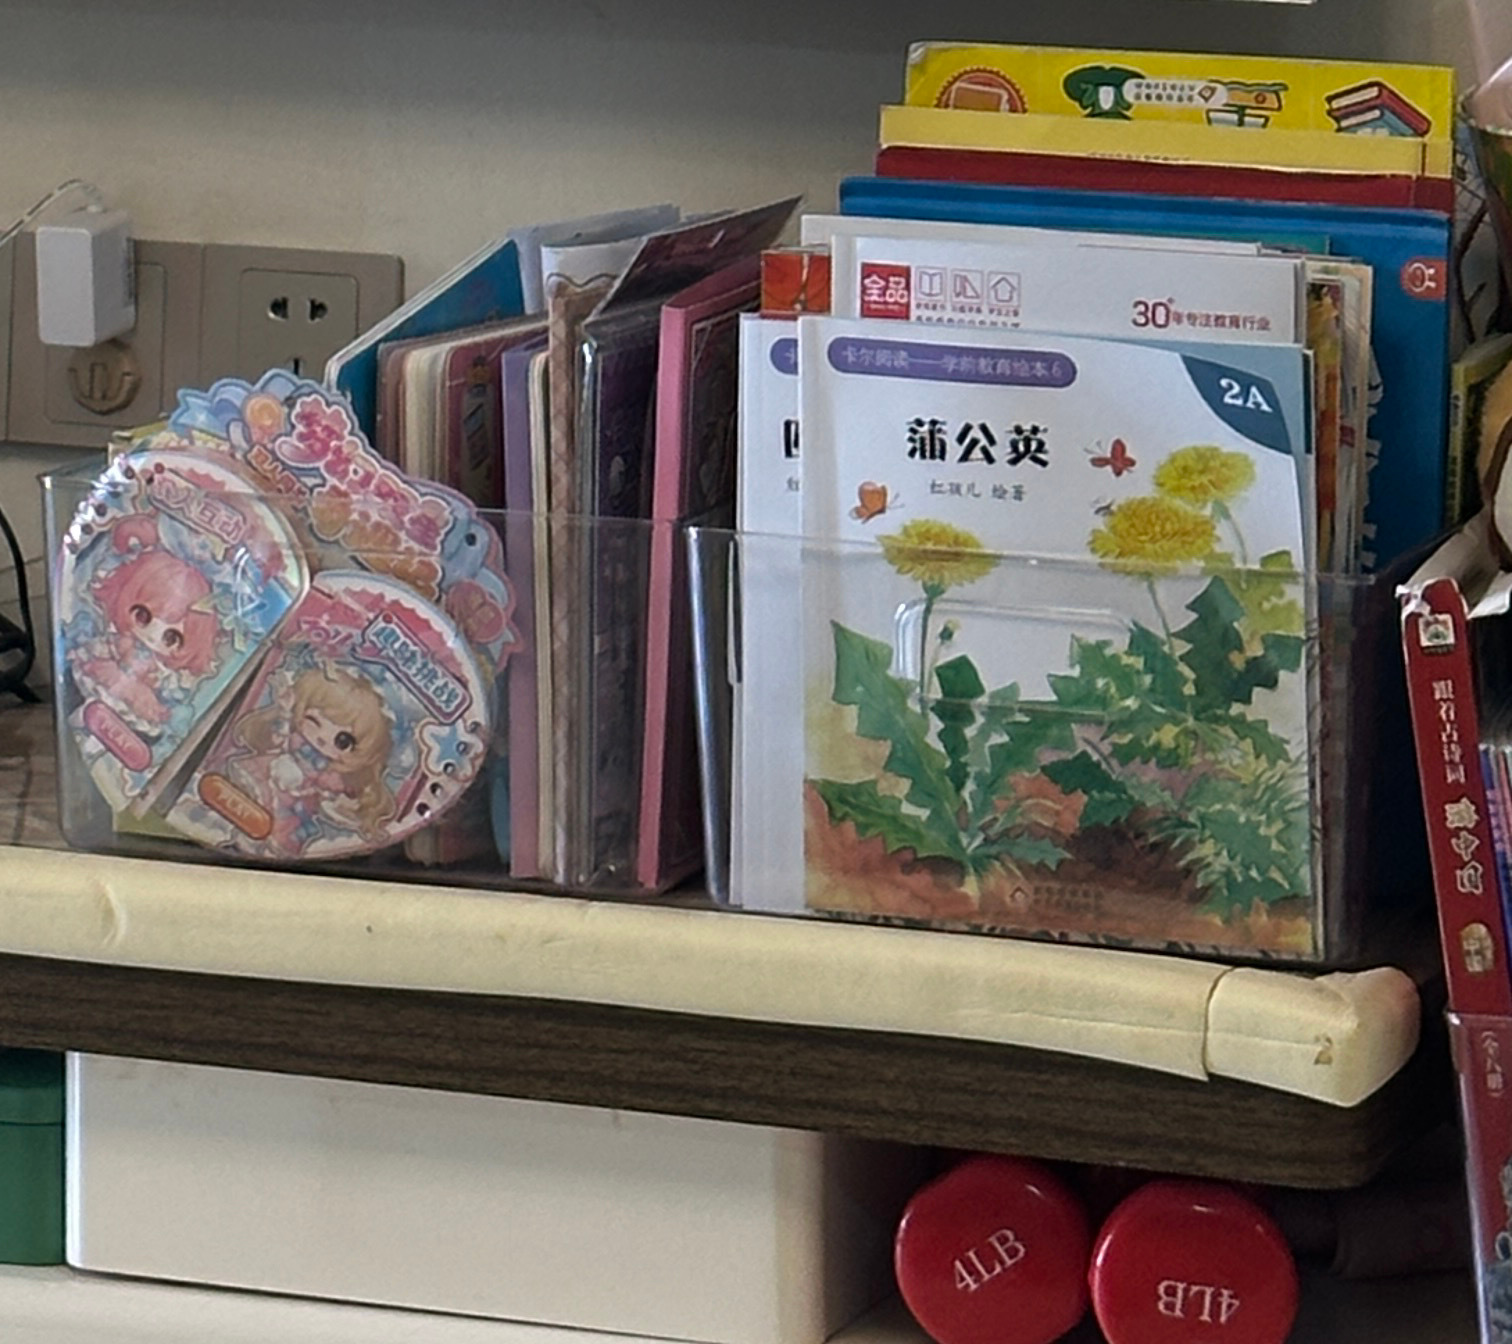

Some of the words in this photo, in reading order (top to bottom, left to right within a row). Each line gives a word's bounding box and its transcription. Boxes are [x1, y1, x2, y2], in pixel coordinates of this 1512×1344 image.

[863, 274, 909, 304] 全品
[1219, 377, 1274, 413] 2A
[905, 417, 1050, 468] 蒲公英
[951, 1227, 1028, 1294] 4LB
[1157, 1279, 1241, 1325] 4LB
